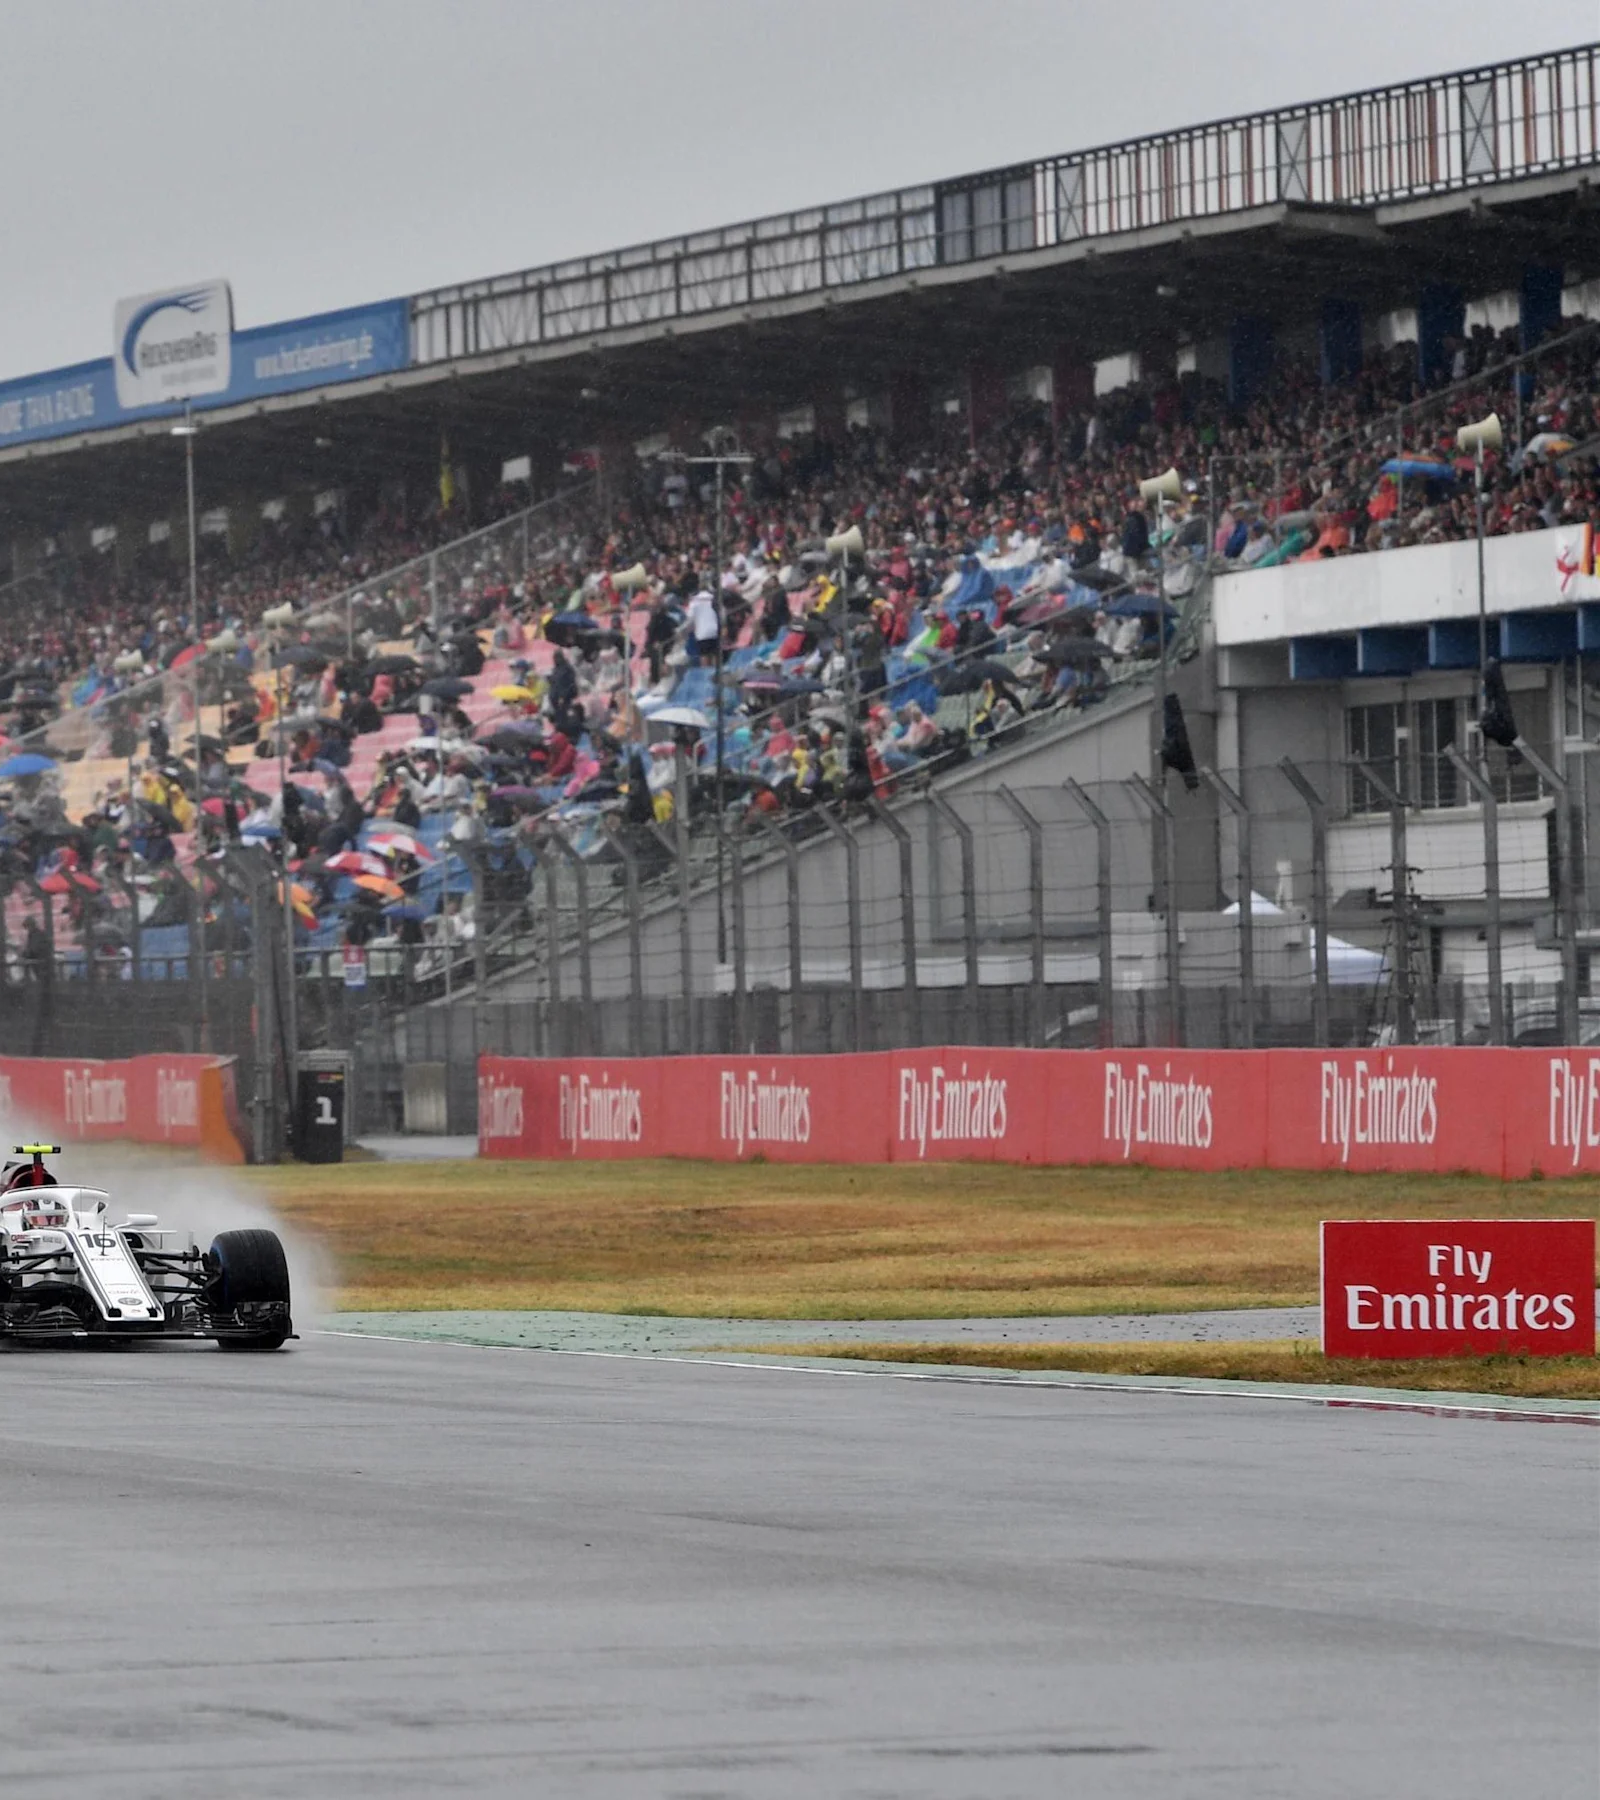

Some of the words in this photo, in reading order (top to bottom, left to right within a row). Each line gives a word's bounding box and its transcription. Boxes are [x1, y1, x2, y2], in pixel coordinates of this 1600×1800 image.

[315, 1095, 337, 1125] 1
[560, 1074, 579, 1155] Fly
[580, 1071, 641, 1142] Emirates
[720, 1071, 746, 1156] Fly
[748, 1068, 811, 1143] Emirates
[900, 1068, 929, 1158] Fly
[931, 1061, 1007, 1140] Emirates
[1104, 1062, 1135, 1159] Fly
[1136, 1061, 1214, 1149] Emirates
[1321, 1060, 1351, 1163] Fly
[1355, 1055, 1437, 1144] Emirates
[1550, 1058, 1584, 1166] Fly
[78, 1233, 116, 1249] 16
[1427, 1244, 1492, 1284] Fly
[1344, 1282, 1576, 1332] Emirates
